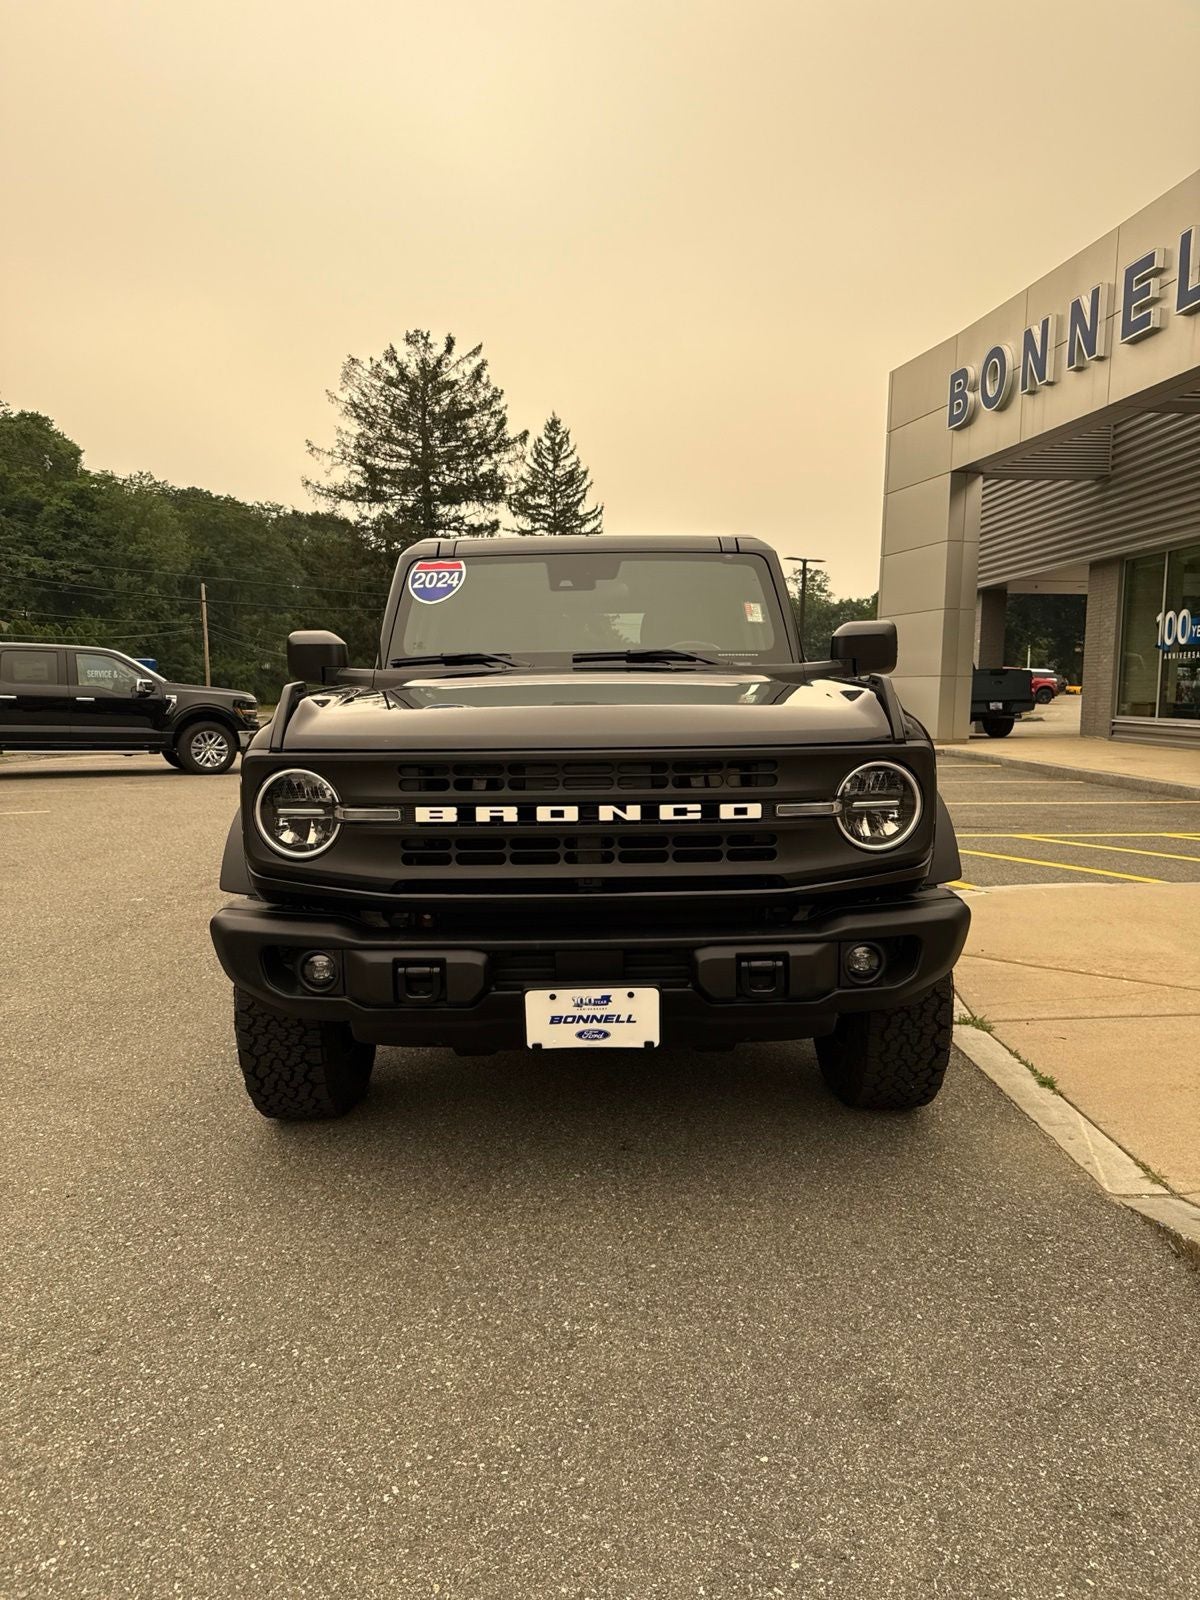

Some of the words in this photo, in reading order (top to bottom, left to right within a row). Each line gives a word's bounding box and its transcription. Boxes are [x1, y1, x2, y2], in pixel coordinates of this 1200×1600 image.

[412, 571, 459, 588] 2024
[1156, 608, 1191, 646] 100
[87, 670, 112, 678] SERVICE
[415, 803, 762, 823] BRONCO
[549, 1014, 637, 1024] BONNELL
